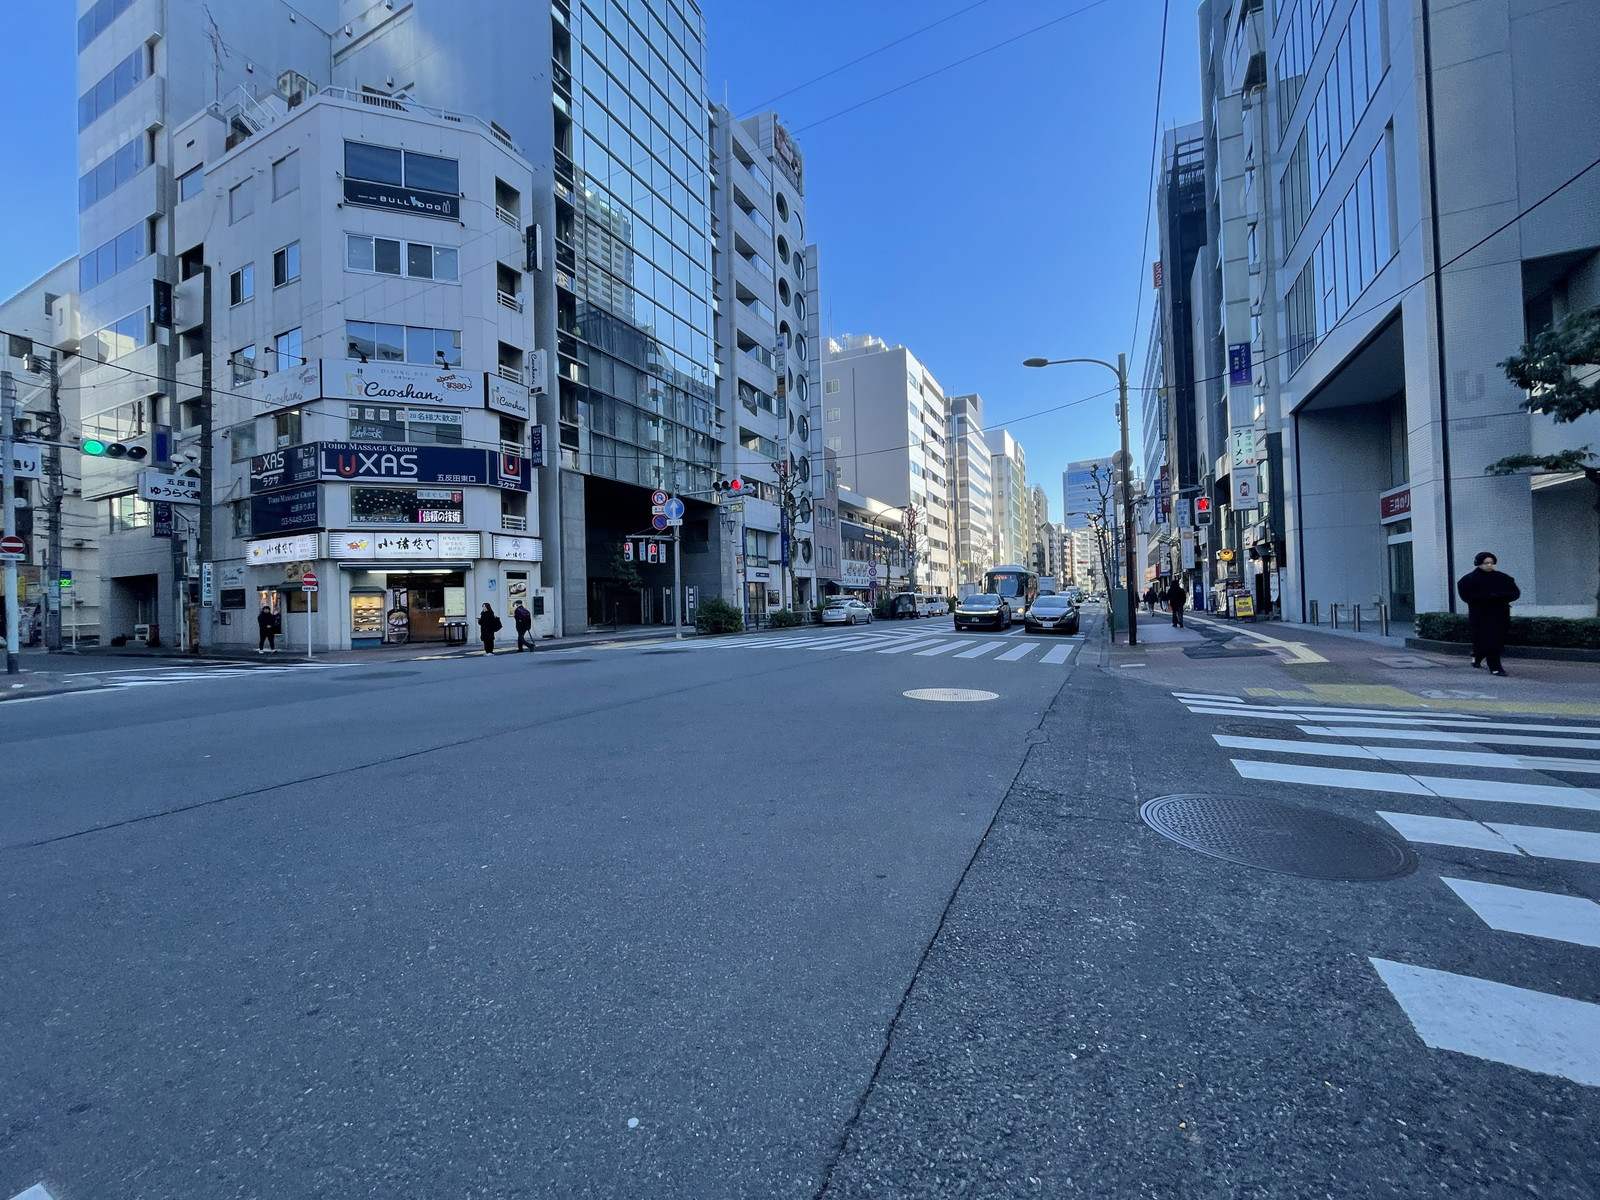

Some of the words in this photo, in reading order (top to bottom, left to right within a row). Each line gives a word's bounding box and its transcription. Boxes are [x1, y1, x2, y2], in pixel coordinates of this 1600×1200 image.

[1234, 430, 1244, 466] ラーメン
[321, 451, 418, 476] LUXAS
[166, 478, 197, 488] 五反田
[437, 474, 476, 483] 五反田東口
[422, 510, 461, 523] 信頼の技術
